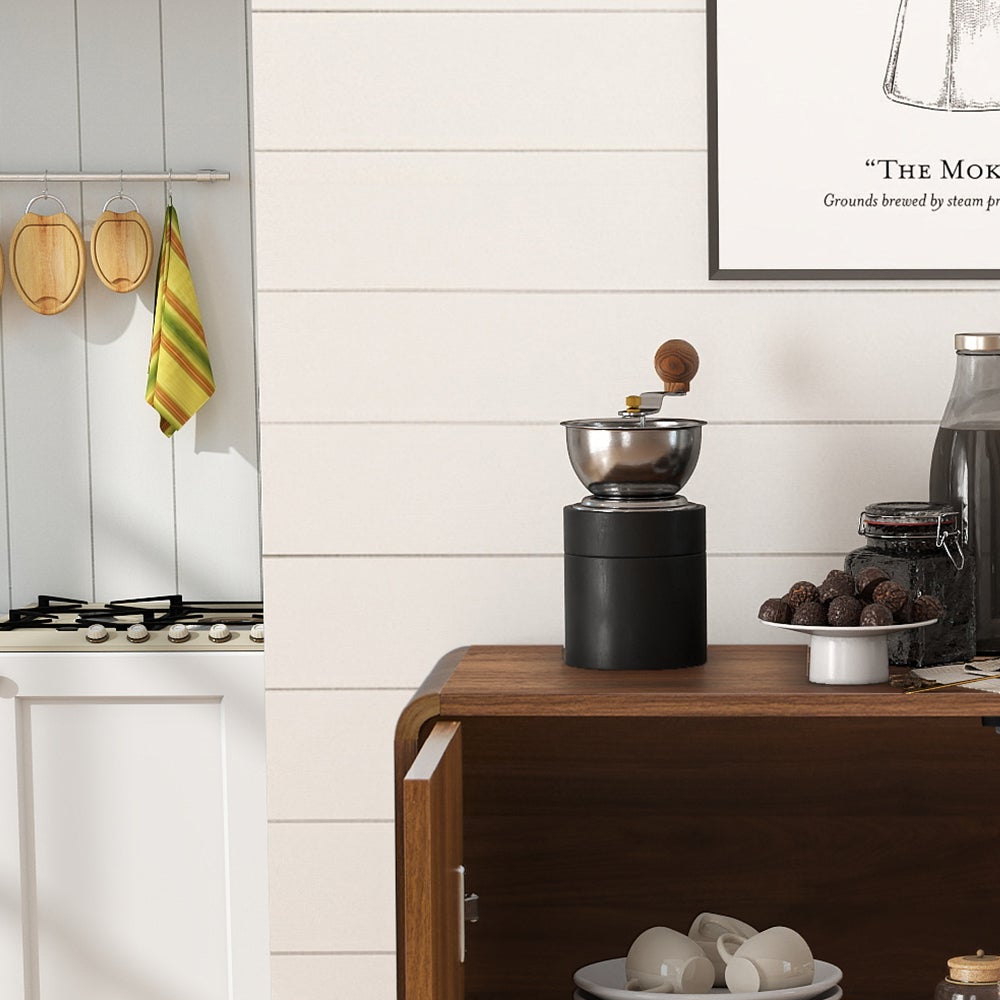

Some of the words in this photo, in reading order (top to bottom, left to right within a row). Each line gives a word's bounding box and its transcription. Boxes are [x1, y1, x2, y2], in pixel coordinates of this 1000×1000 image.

[823, 193, 879, 207] Grounds
[881, 193, 928, 207] brewed
[930, 193, 945, 212] by
[947, 195, 984, 207] steam
